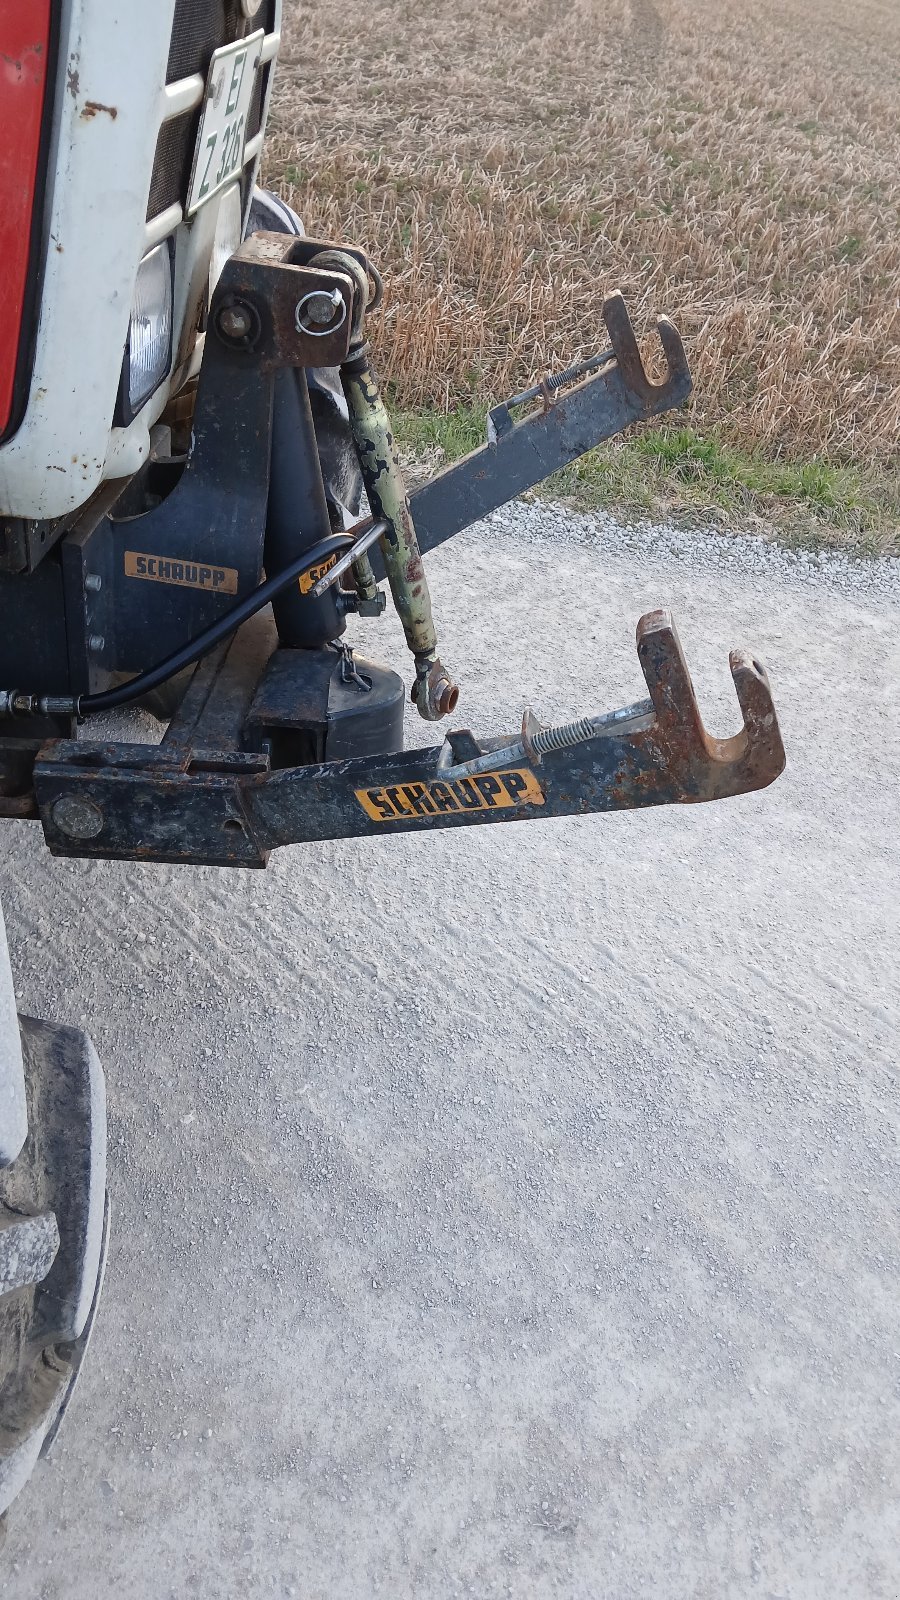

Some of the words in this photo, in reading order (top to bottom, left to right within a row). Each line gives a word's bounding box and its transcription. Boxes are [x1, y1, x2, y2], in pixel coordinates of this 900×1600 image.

[225, 49, 247, 116] EI
[198, 131, 217, 199] Z
[216, 112, 244, 184] 326
[136, 556, 225, 587] SCHAUPP
[367, 772, 527, 818] SCHAUPP
